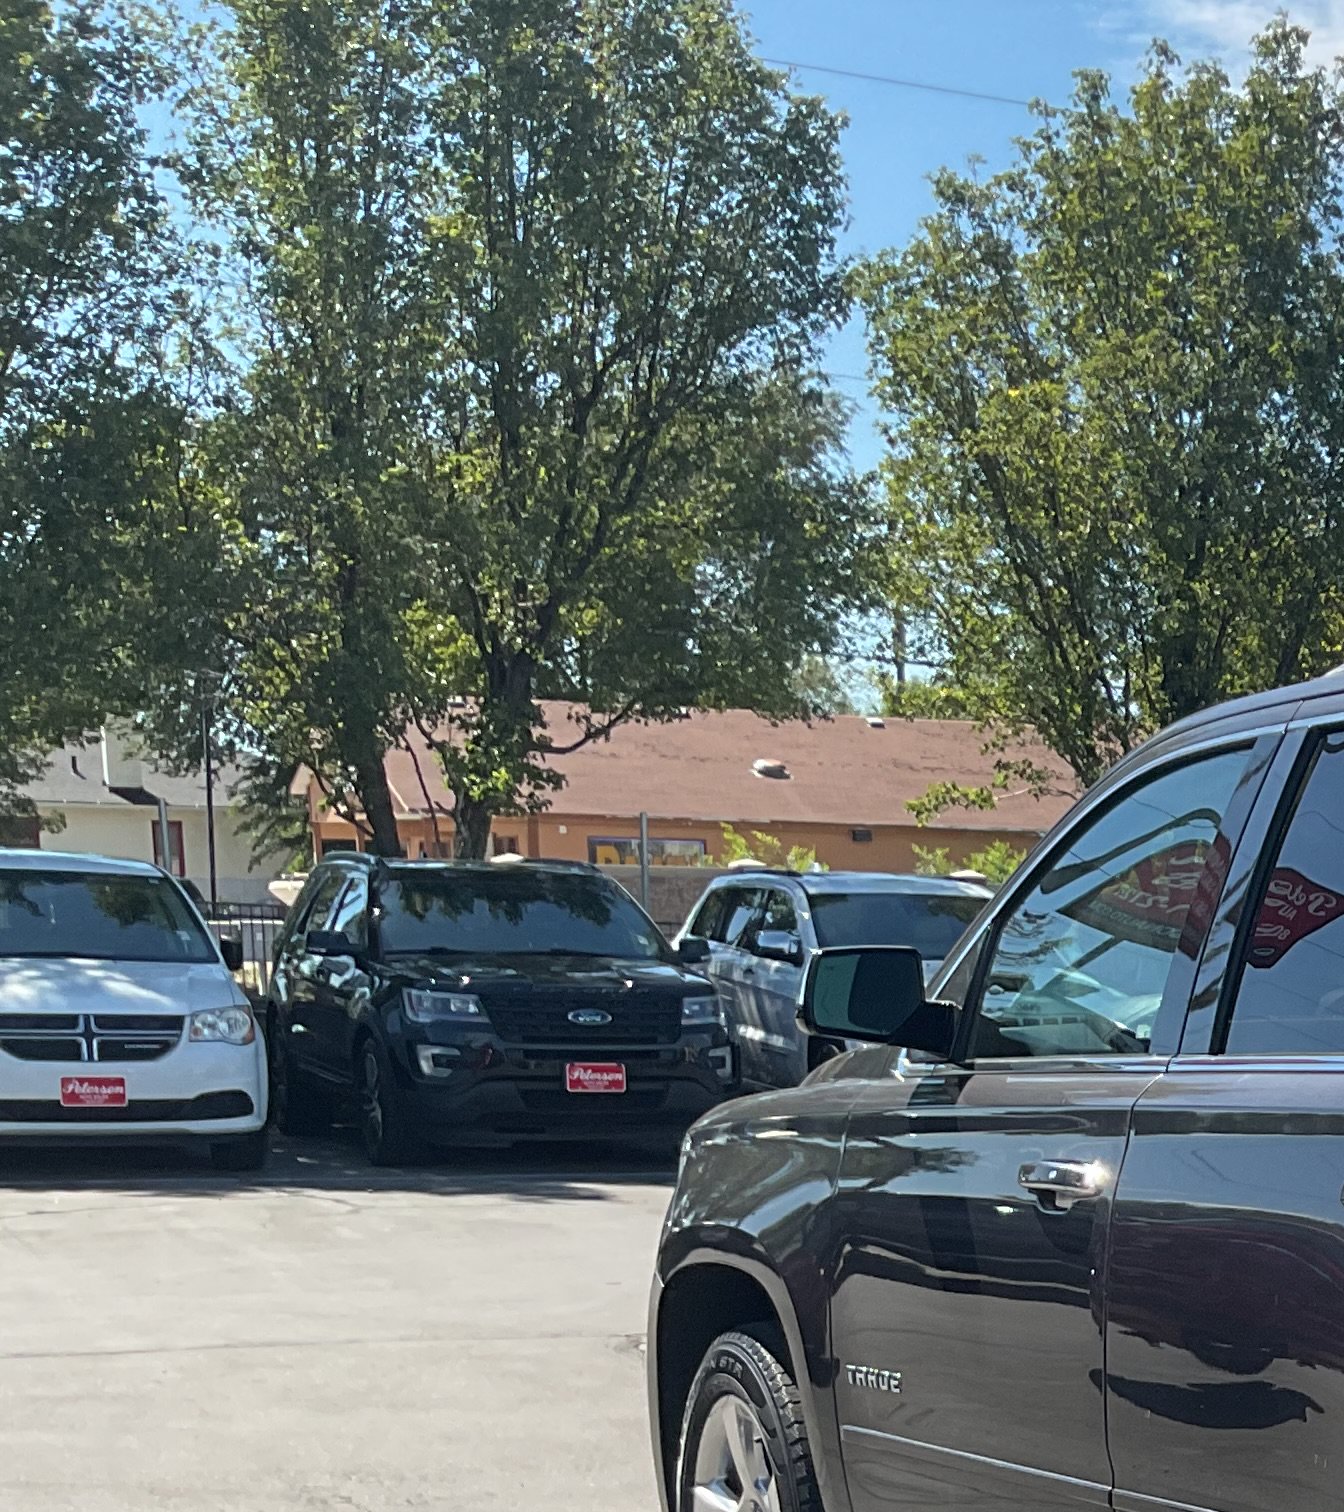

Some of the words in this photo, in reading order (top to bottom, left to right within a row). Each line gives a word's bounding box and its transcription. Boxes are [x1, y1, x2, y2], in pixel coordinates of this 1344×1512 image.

[569, 1067, 623, 1080] Peterson
[62, 1079, 124, 1094] Peterson
[846, 1364, 902, 1393] TAHOE
